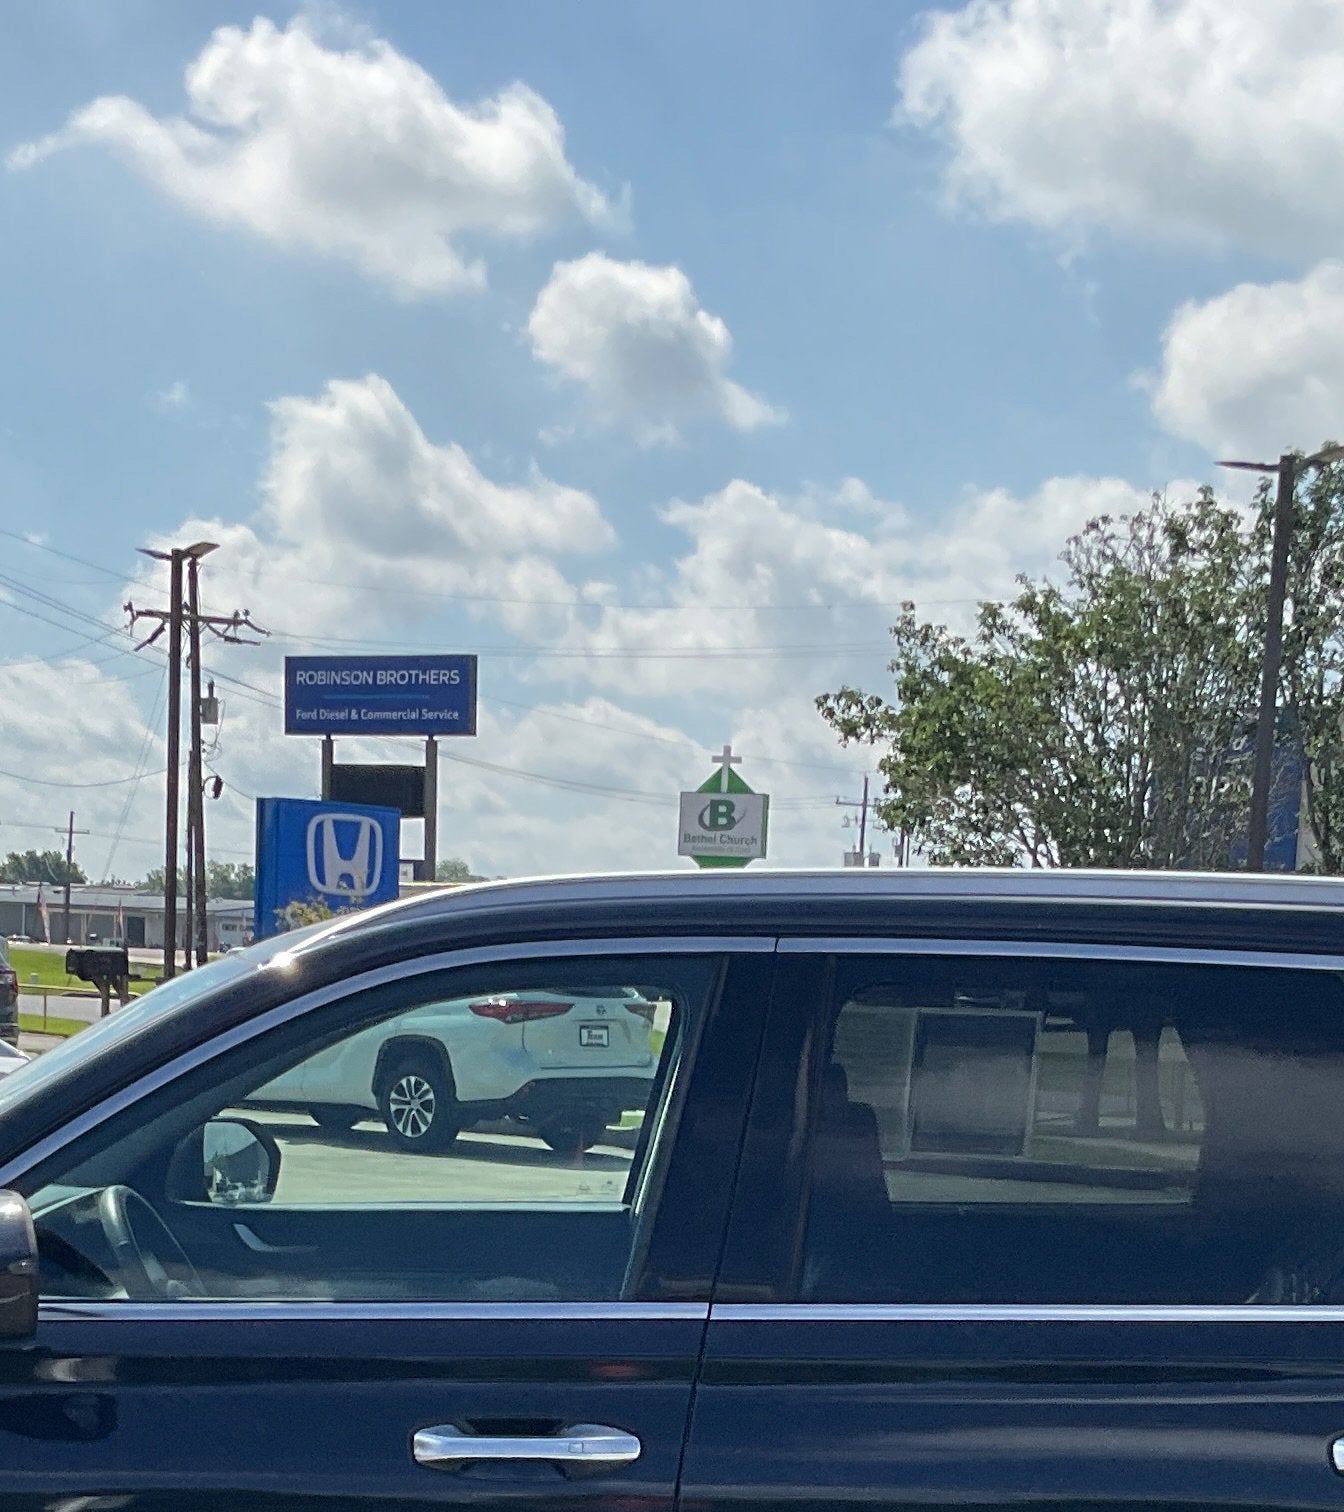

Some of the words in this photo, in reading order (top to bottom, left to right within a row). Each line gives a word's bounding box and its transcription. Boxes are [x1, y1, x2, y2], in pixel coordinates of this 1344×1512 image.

[296, 671, 374, 686] ROBINSON
[376, 670, 461, 685] BROTHERS
[296, 709, 318, 721] Ford
[319, 709, 349, 721] Diesel
[350, 709, 359, 721] &
[360, 708, 419, 721] Commercial
[421, 708, 460, 721] Service
[683, 832, 717, 844] Bethel
[719, 832, 758, 845] Church
